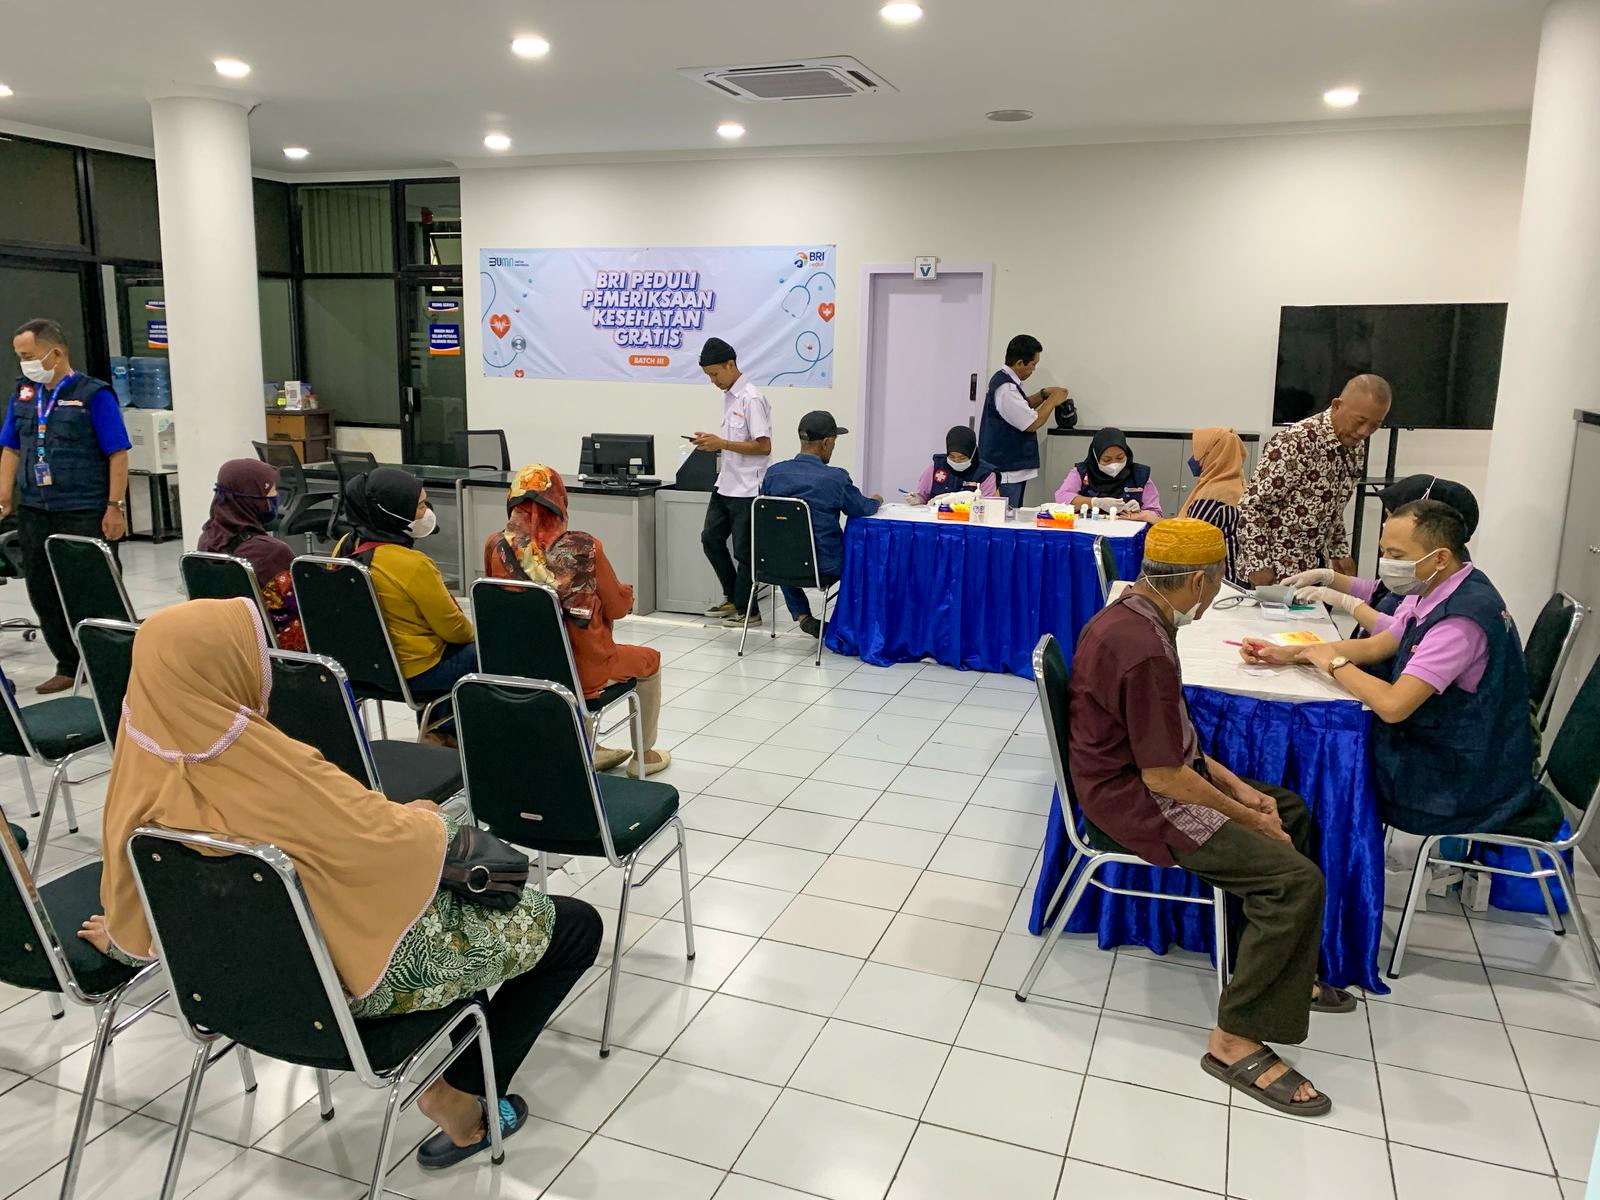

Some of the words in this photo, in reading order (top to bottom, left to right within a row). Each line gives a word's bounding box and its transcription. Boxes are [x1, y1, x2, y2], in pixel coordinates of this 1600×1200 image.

[809, 251, 825, 261] BRI
[596, 270, 628, 290] BRI
[631, 270, 699, 291] PEDULI
[582, 289, 716, 311] PEMERIKSAAN
[593, 309, 704, 330] KESEHATAN
[614, 328, 682, 348] GRATIS
[633, 356, 656, 365] BATCH
